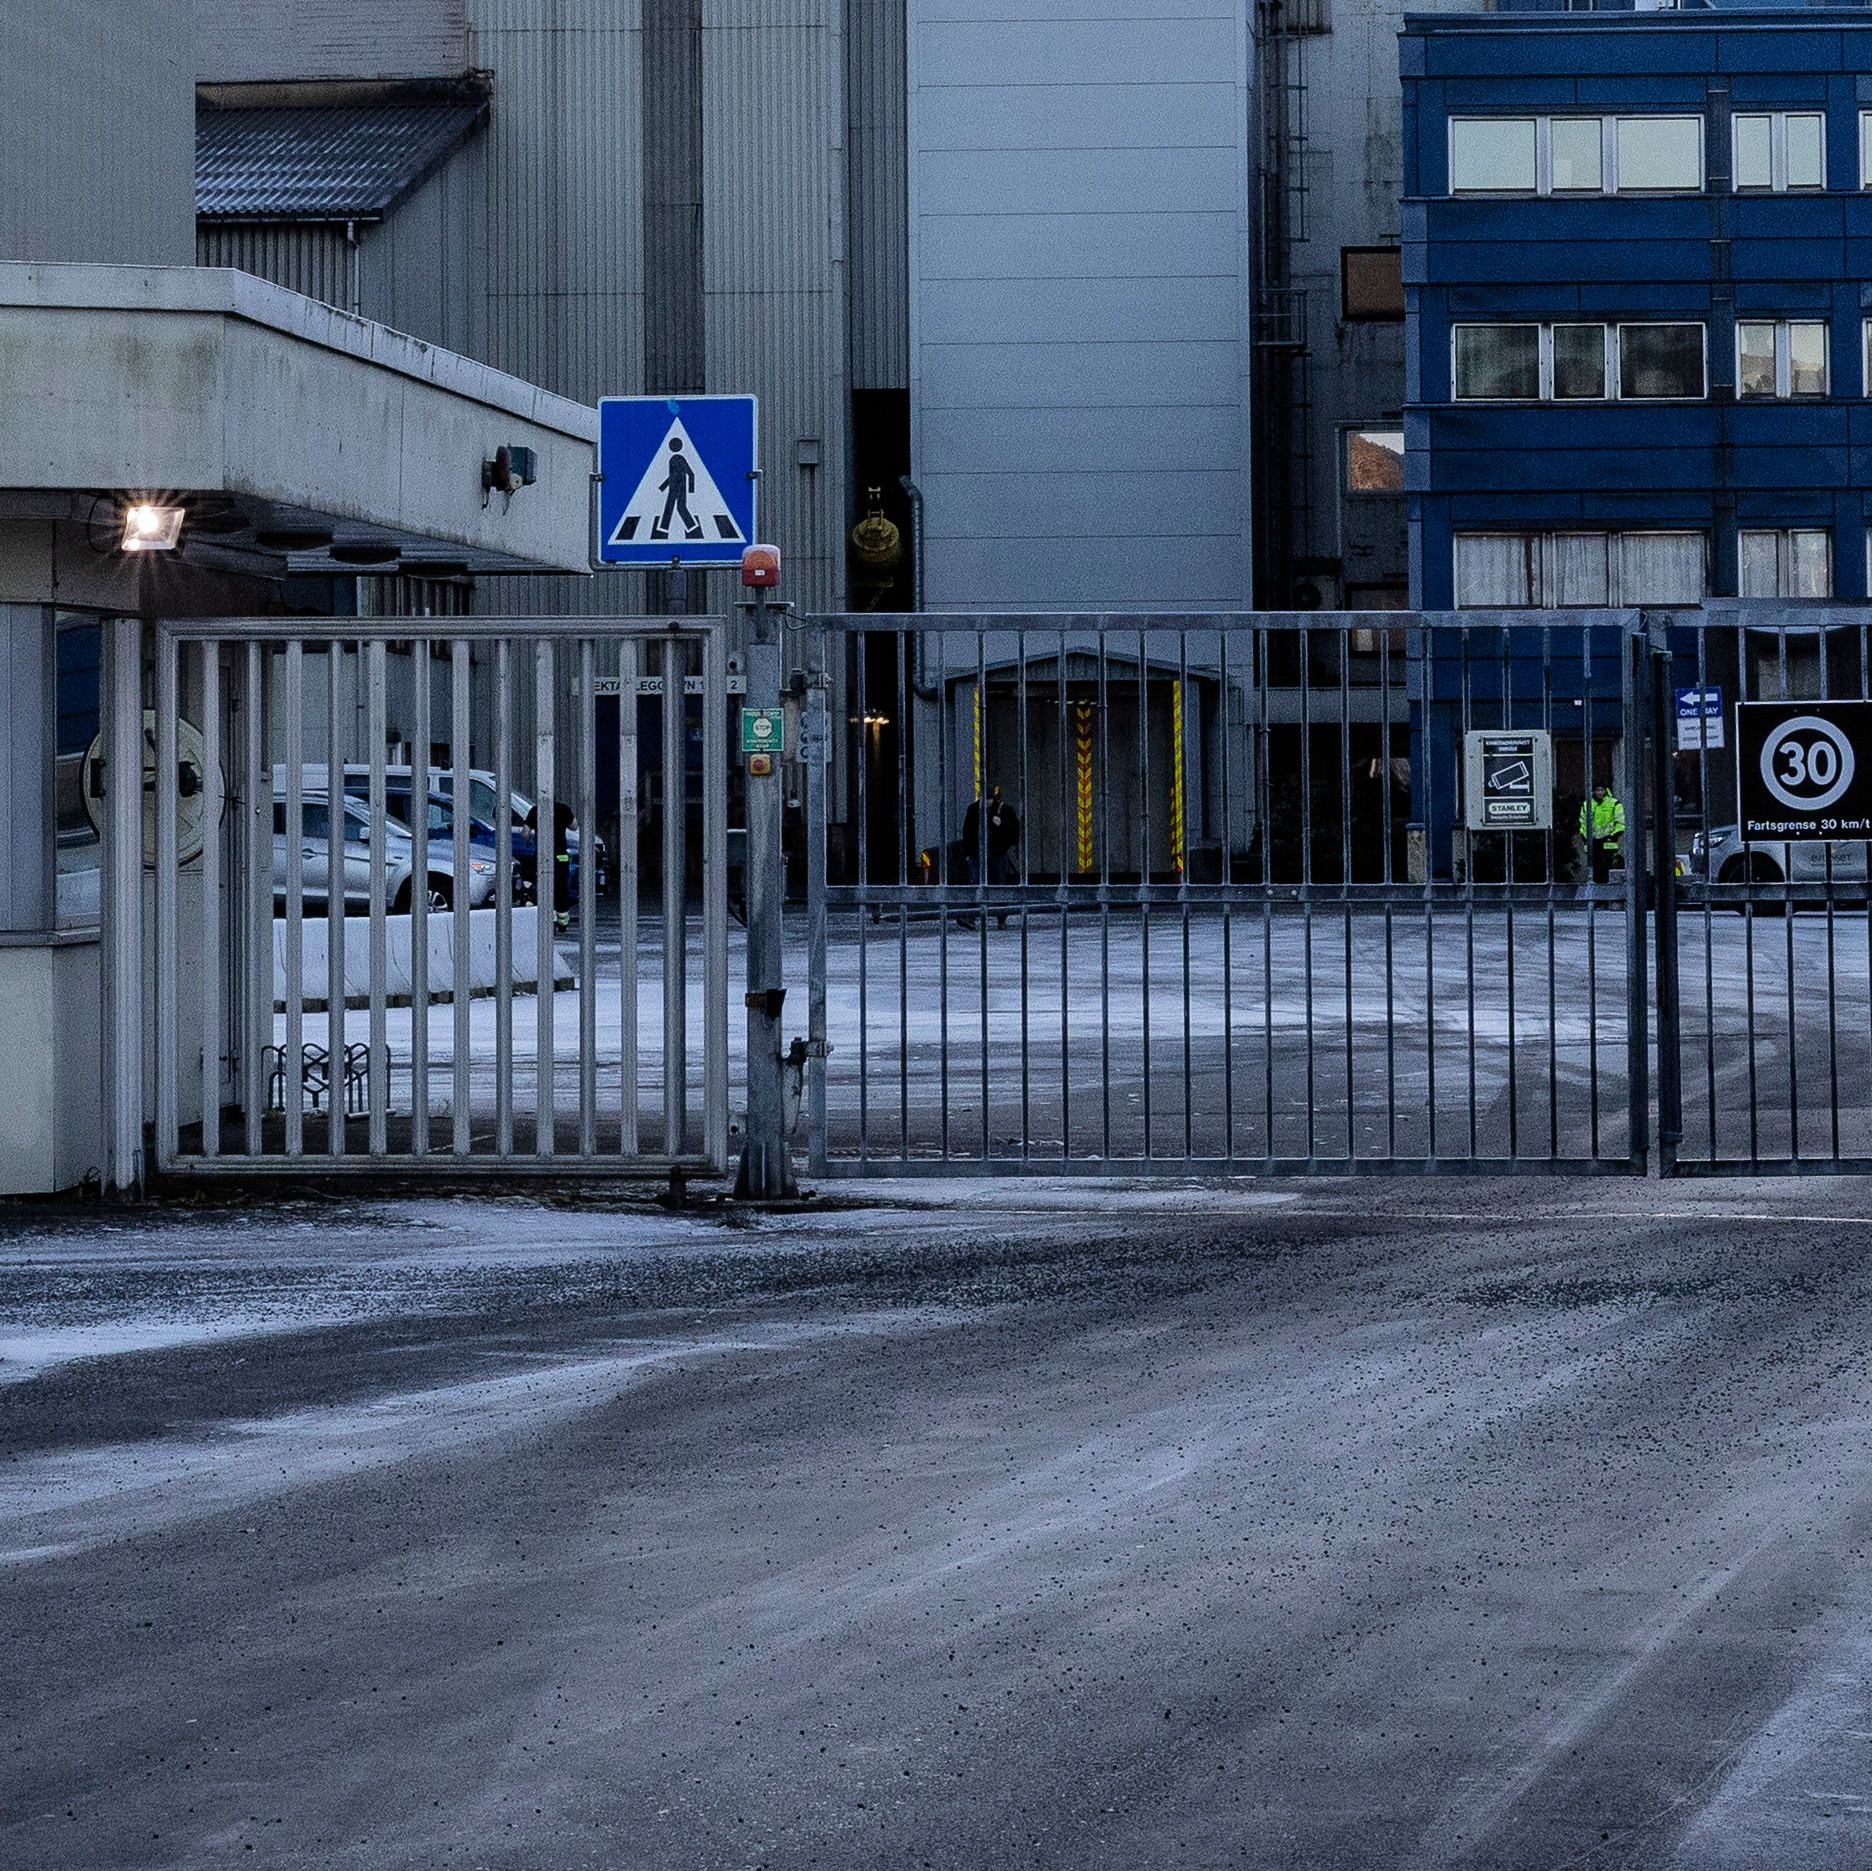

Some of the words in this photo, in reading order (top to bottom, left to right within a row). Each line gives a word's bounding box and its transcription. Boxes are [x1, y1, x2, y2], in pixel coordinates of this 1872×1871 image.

[731, 680, 738, 690] 2
[1680, 708, 1698, 716] ONE
[1778, 741, 1837, 787] 30
[1492, 804, 1527, 812] STANLEY
[1747, 819, 1817, 834] Fartsgrense
[1821, 818, 1837, 830] 30
[1841, 817, 1871, 830] km/t
